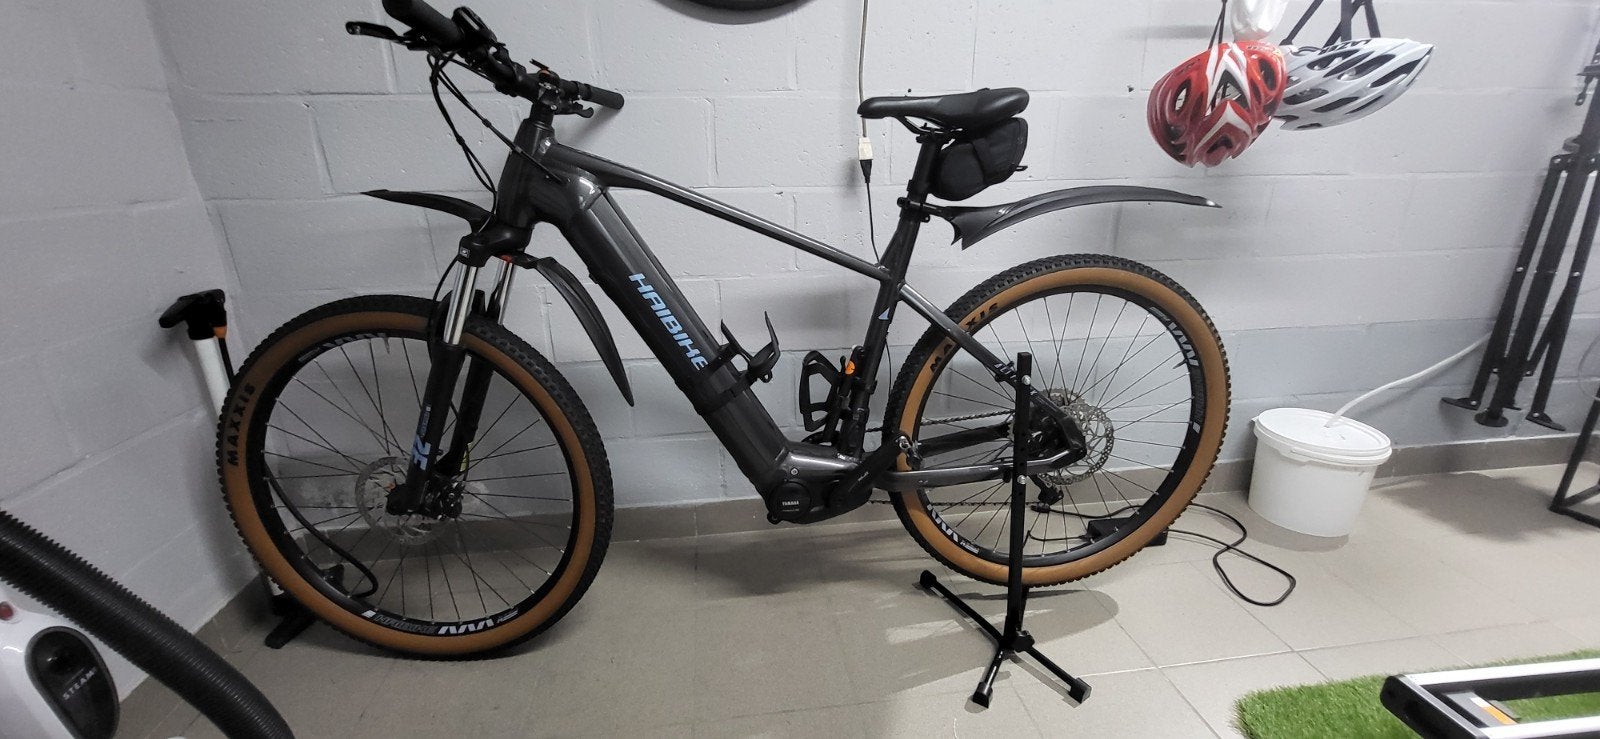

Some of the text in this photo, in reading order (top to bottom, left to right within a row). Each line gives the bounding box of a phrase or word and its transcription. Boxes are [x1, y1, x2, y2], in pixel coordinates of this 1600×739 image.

[628, 273, 709, 371] HAIBIKE
[226, 382, 255, 467] MAXXIS
[62, 667, 96, 700] STEAM
